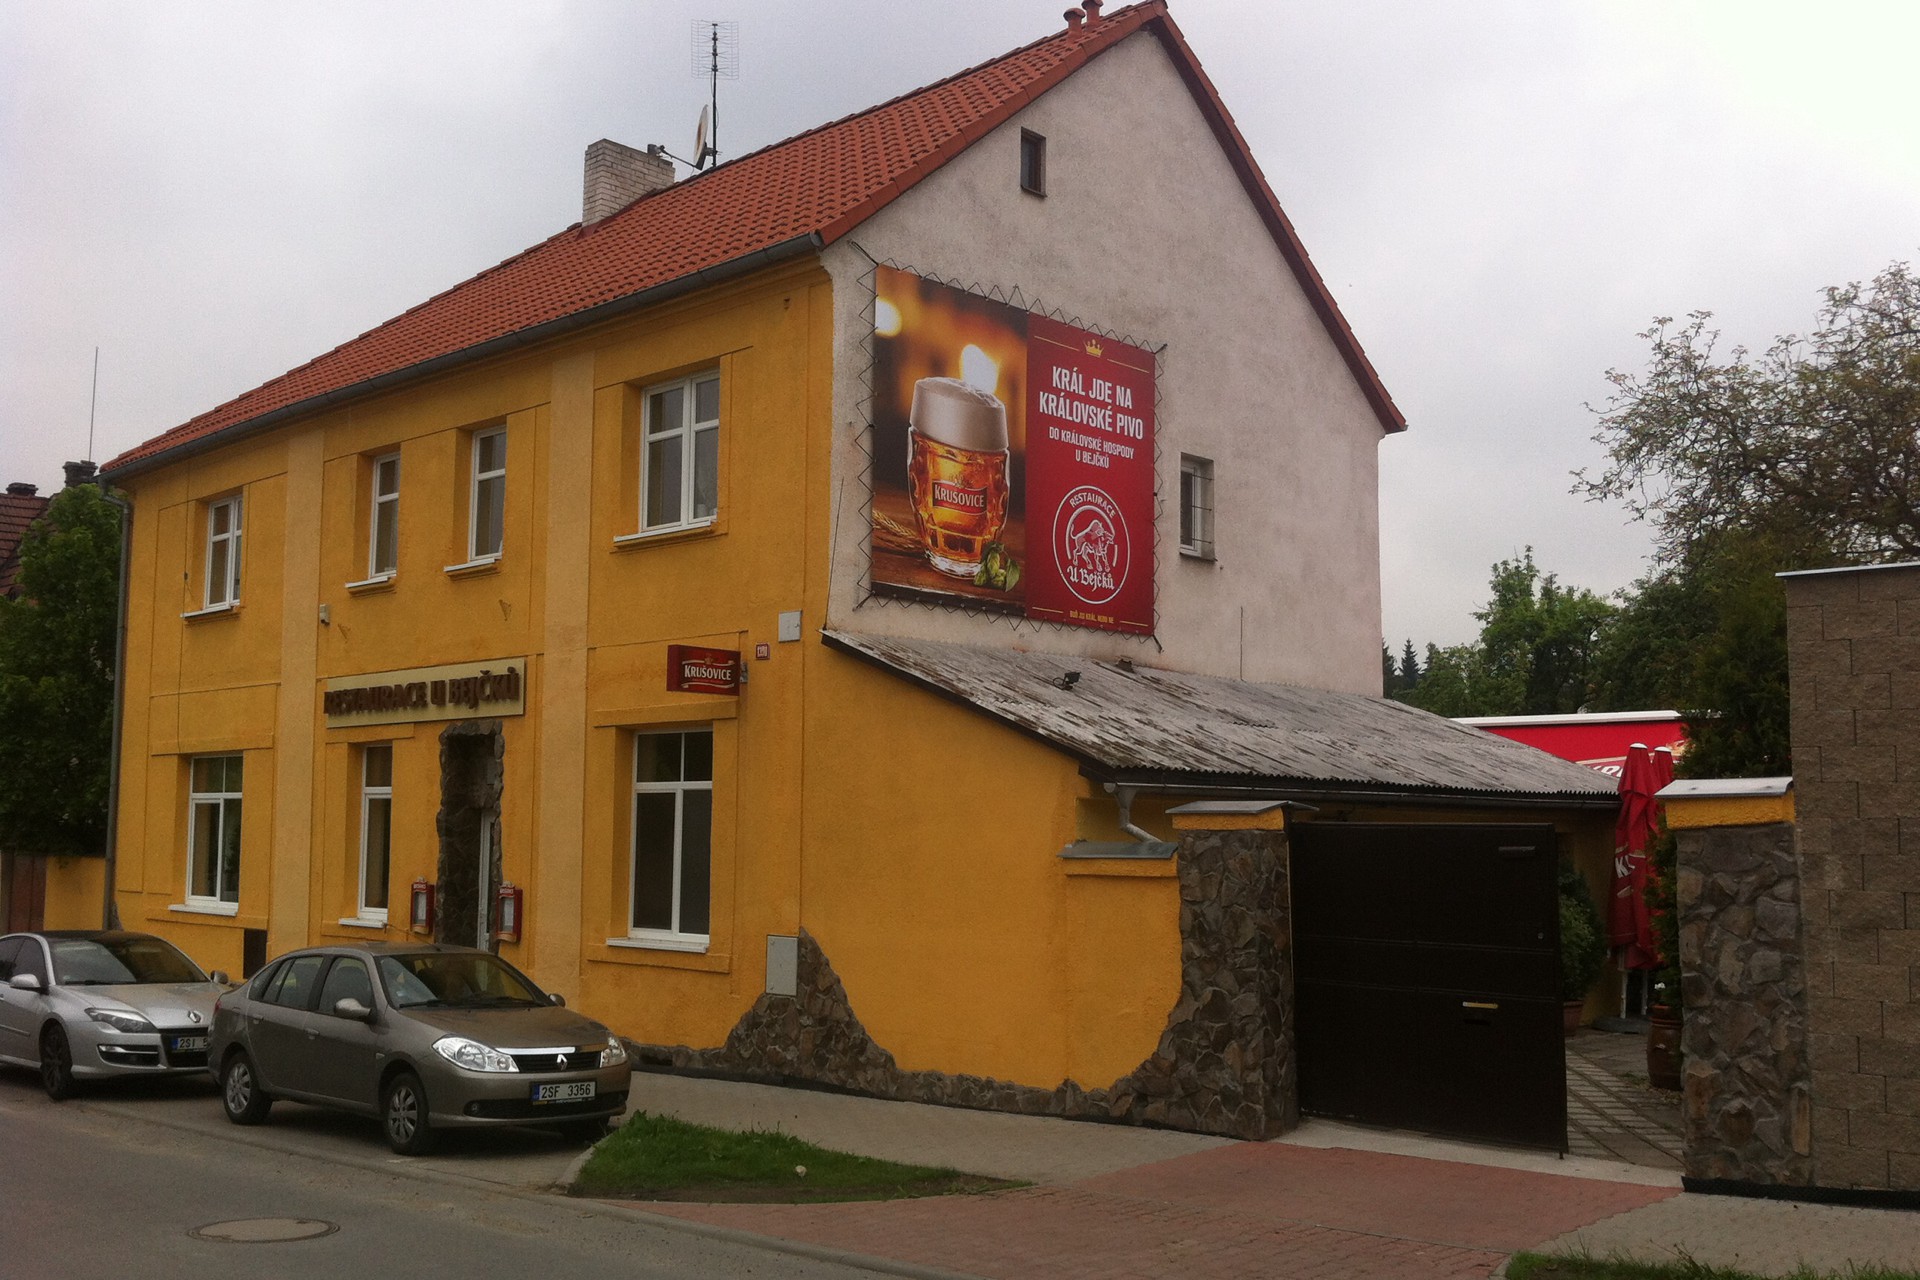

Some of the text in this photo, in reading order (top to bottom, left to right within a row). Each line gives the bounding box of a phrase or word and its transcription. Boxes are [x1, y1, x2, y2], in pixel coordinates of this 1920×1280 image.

[1052, 366, 1132, 409] KRÁL JDE NA
[1039, 391, 1143, 440] KRÁLOVSKÉ PIVO
[1049, 426, 1134, 459] DO KRÁLOVSKÉ HOSPODY
[1075, 449, 1081, 461] U
[1069, 492, 1116, 519] RESTAURACE
[1066, 565, 1078, 582] U
[684, 664, 732, 680] KRUŠOVICE
[323, 666, 520, 715] RESTAURACE U BEJČKŮ
[541, 1084, 591, 1099] 2SF 3356
